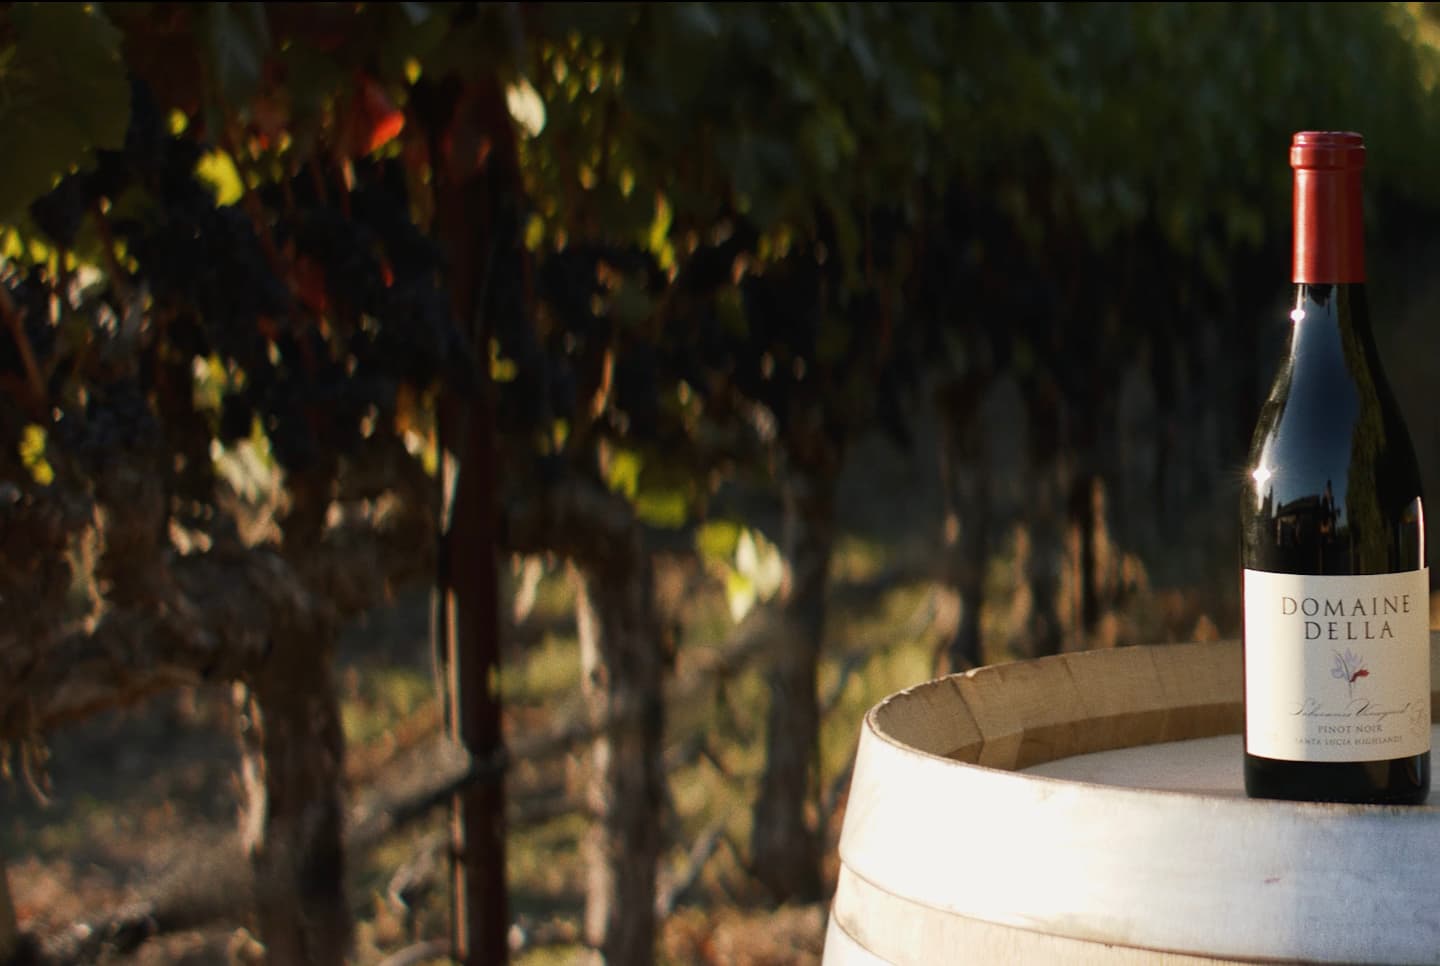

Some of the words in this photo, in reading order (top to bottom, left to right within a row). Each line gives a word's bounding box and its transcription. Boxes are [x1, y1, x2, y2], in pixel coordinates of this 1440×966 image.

[1281, 594, 1410, 617] DOMAINE
[1303, 620, 1395, 640] DELLA
[1318, 725, 1352, 734] PINOT
[1355, 724, 1384, 733] NOIR
